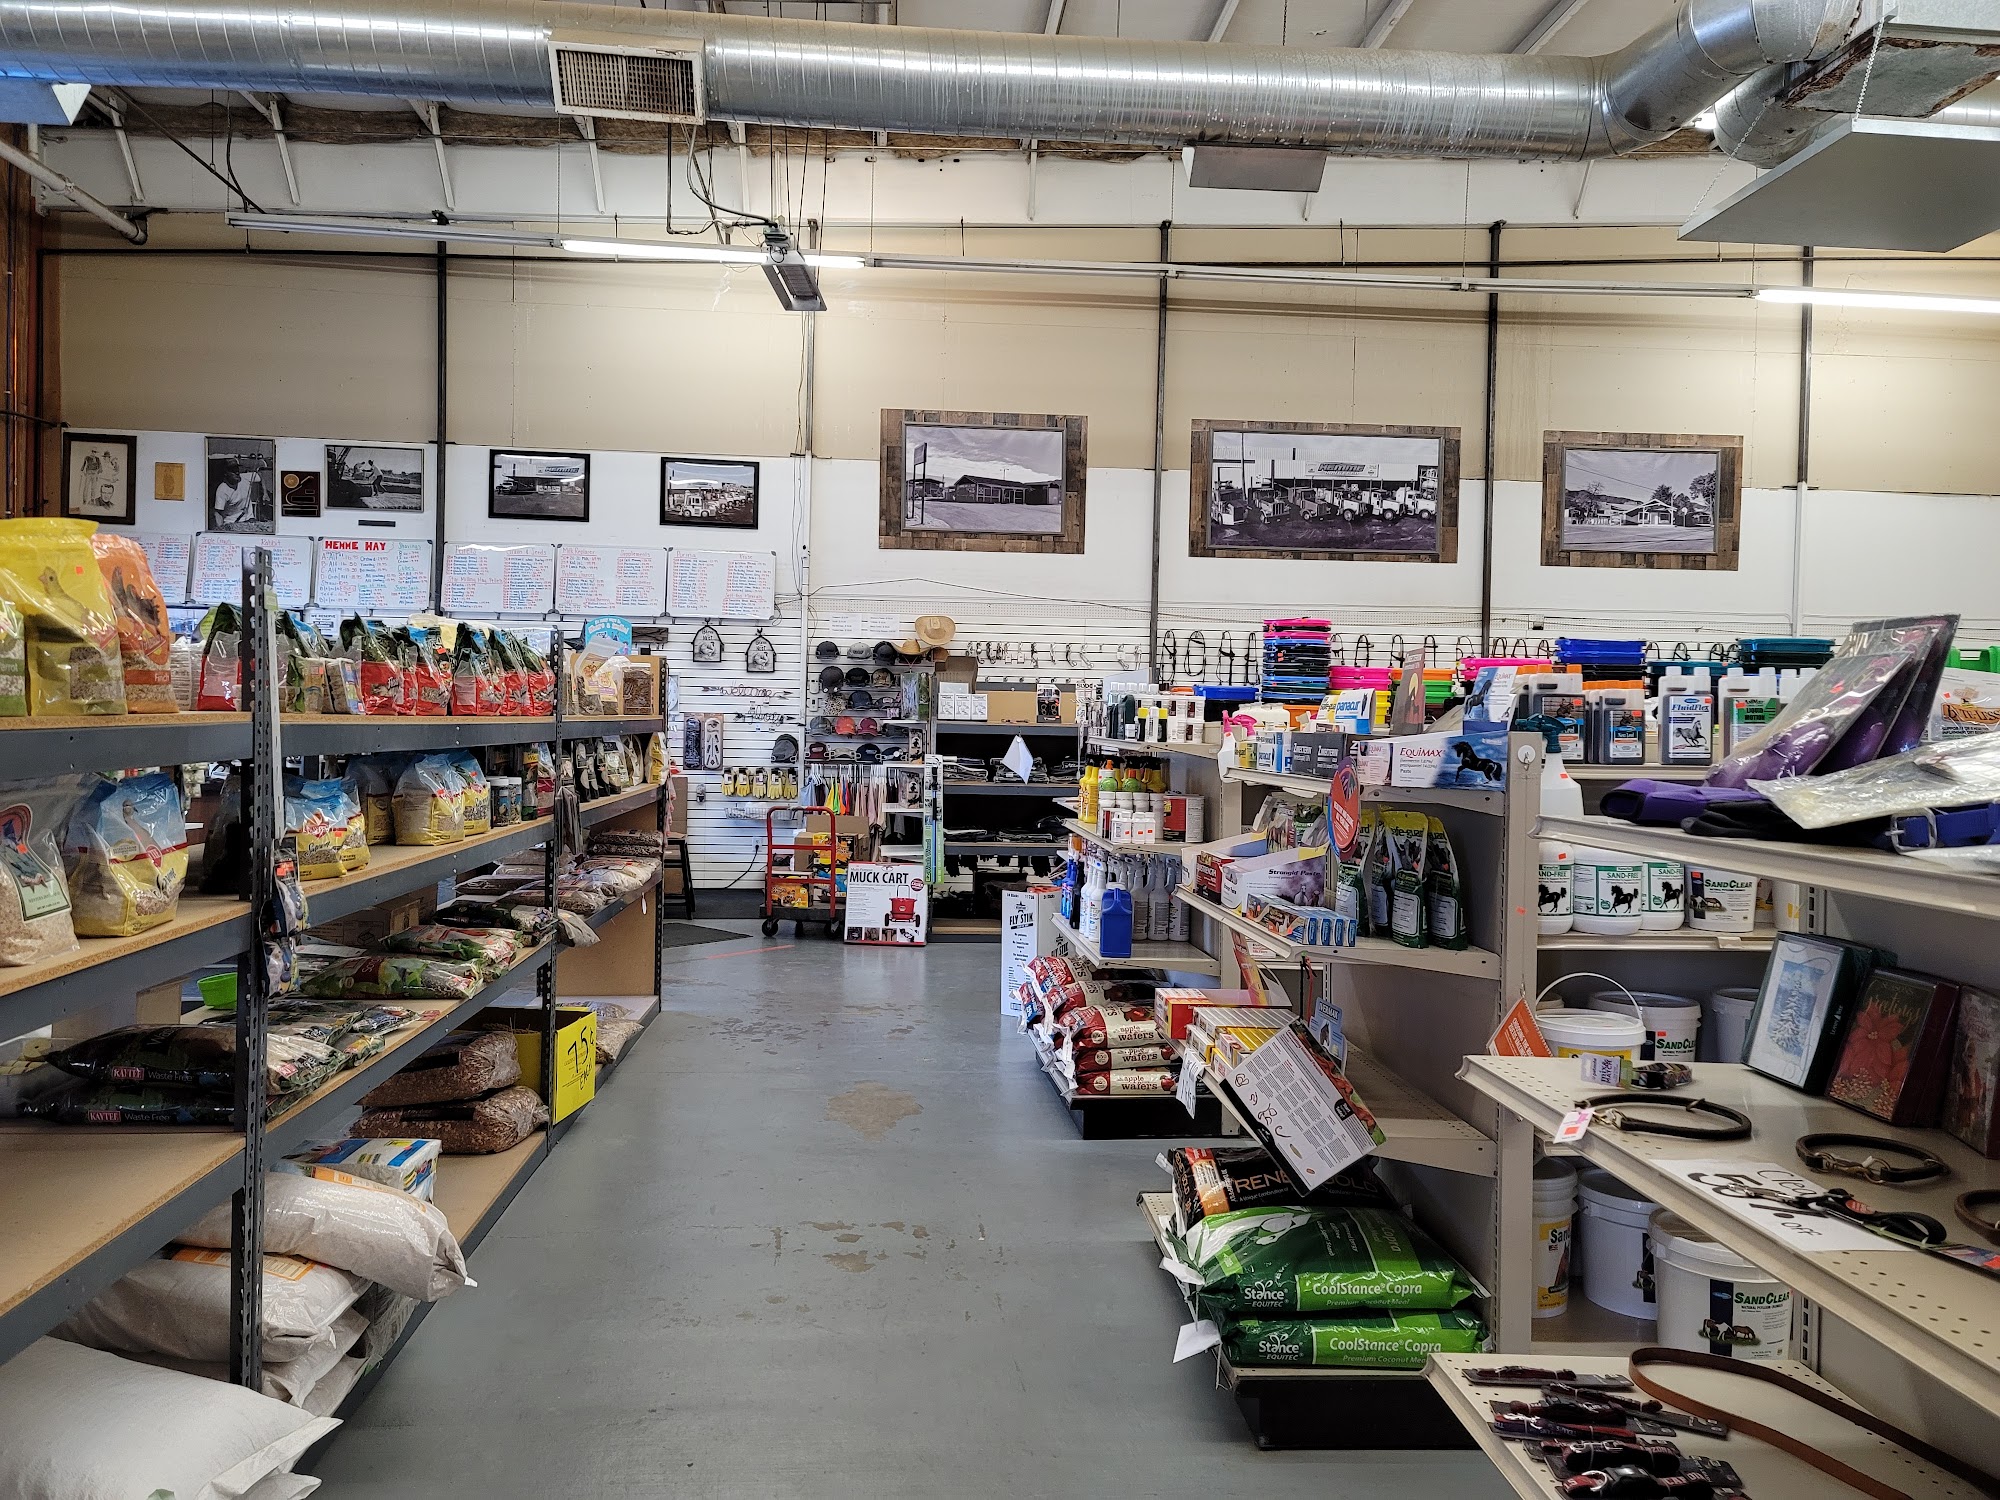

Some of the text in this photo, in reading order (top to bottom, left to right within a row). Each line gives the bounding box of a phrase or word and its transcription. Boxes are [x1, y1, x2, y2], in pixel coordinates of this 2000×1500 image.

[365, 542, 386, 550] HAY
[398, 542, 421, 550] Shavings
[154, 673, 170, 682] Finch
[1336, 701, 1361, 714] panacur
[1671, 704, 1710, 712] FluidFlex
[850, 872, 909, 884] MUCK CART
[1269, 868, 1299, 876] Strongid
[1009, 912, 1033, 925] FLY STIK
[1060, 942, 1068, 957] STIK
[1118, 1032, 1154, 1041] wafers
[1122, 1052, 1158, 1062] wafers
[148, 1070, 192, 1082] Waste Free
[1121, 1082, 1158, 1090] wafers
[125, 1113, 170, 1122] Waste Free
[1235, 1170, 1290, 1194] RENE
[1244, 1284, 1284, 1300] Stance
[1386, 1282, 1422, 1296] Copra
[1258, 1336, 1299, 1354] Stance
[1404, 1339, 1441, 1353] Copra
